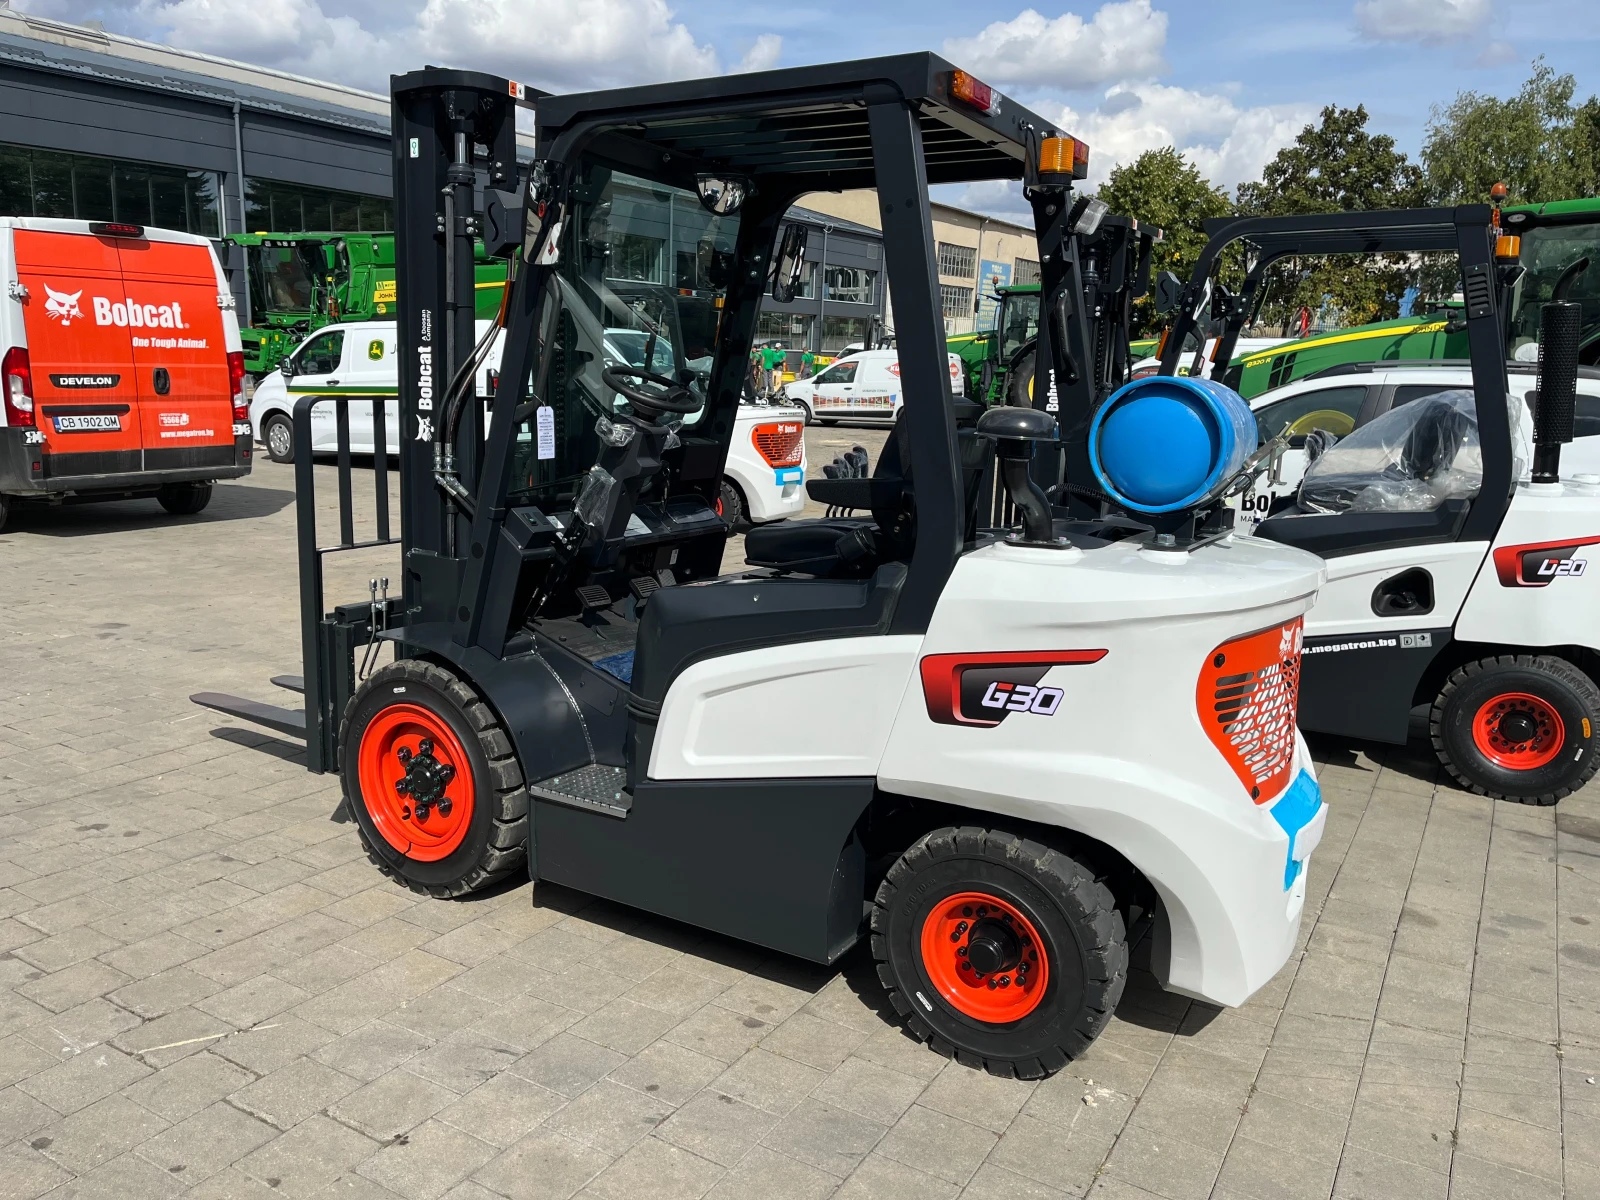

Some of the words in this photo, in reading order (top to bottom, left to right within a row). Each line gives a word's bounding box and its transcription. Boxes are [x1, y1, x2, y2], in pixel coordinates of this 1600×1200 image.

[93, 296, 184, 329] Bobcat
[132, 337, 150, 347] One
[150, 337, 177, 349] Tough
[60, 377, 112, 385] DEVELON
[417, 346, 433, 411] Bobcat
[78, 416, 103, 427] 1902
[1537, 559, 1588, 576] D20
[1300, 638, 1397, 655] w.megatron.bg
[981, 681, 1065, 716] G30
